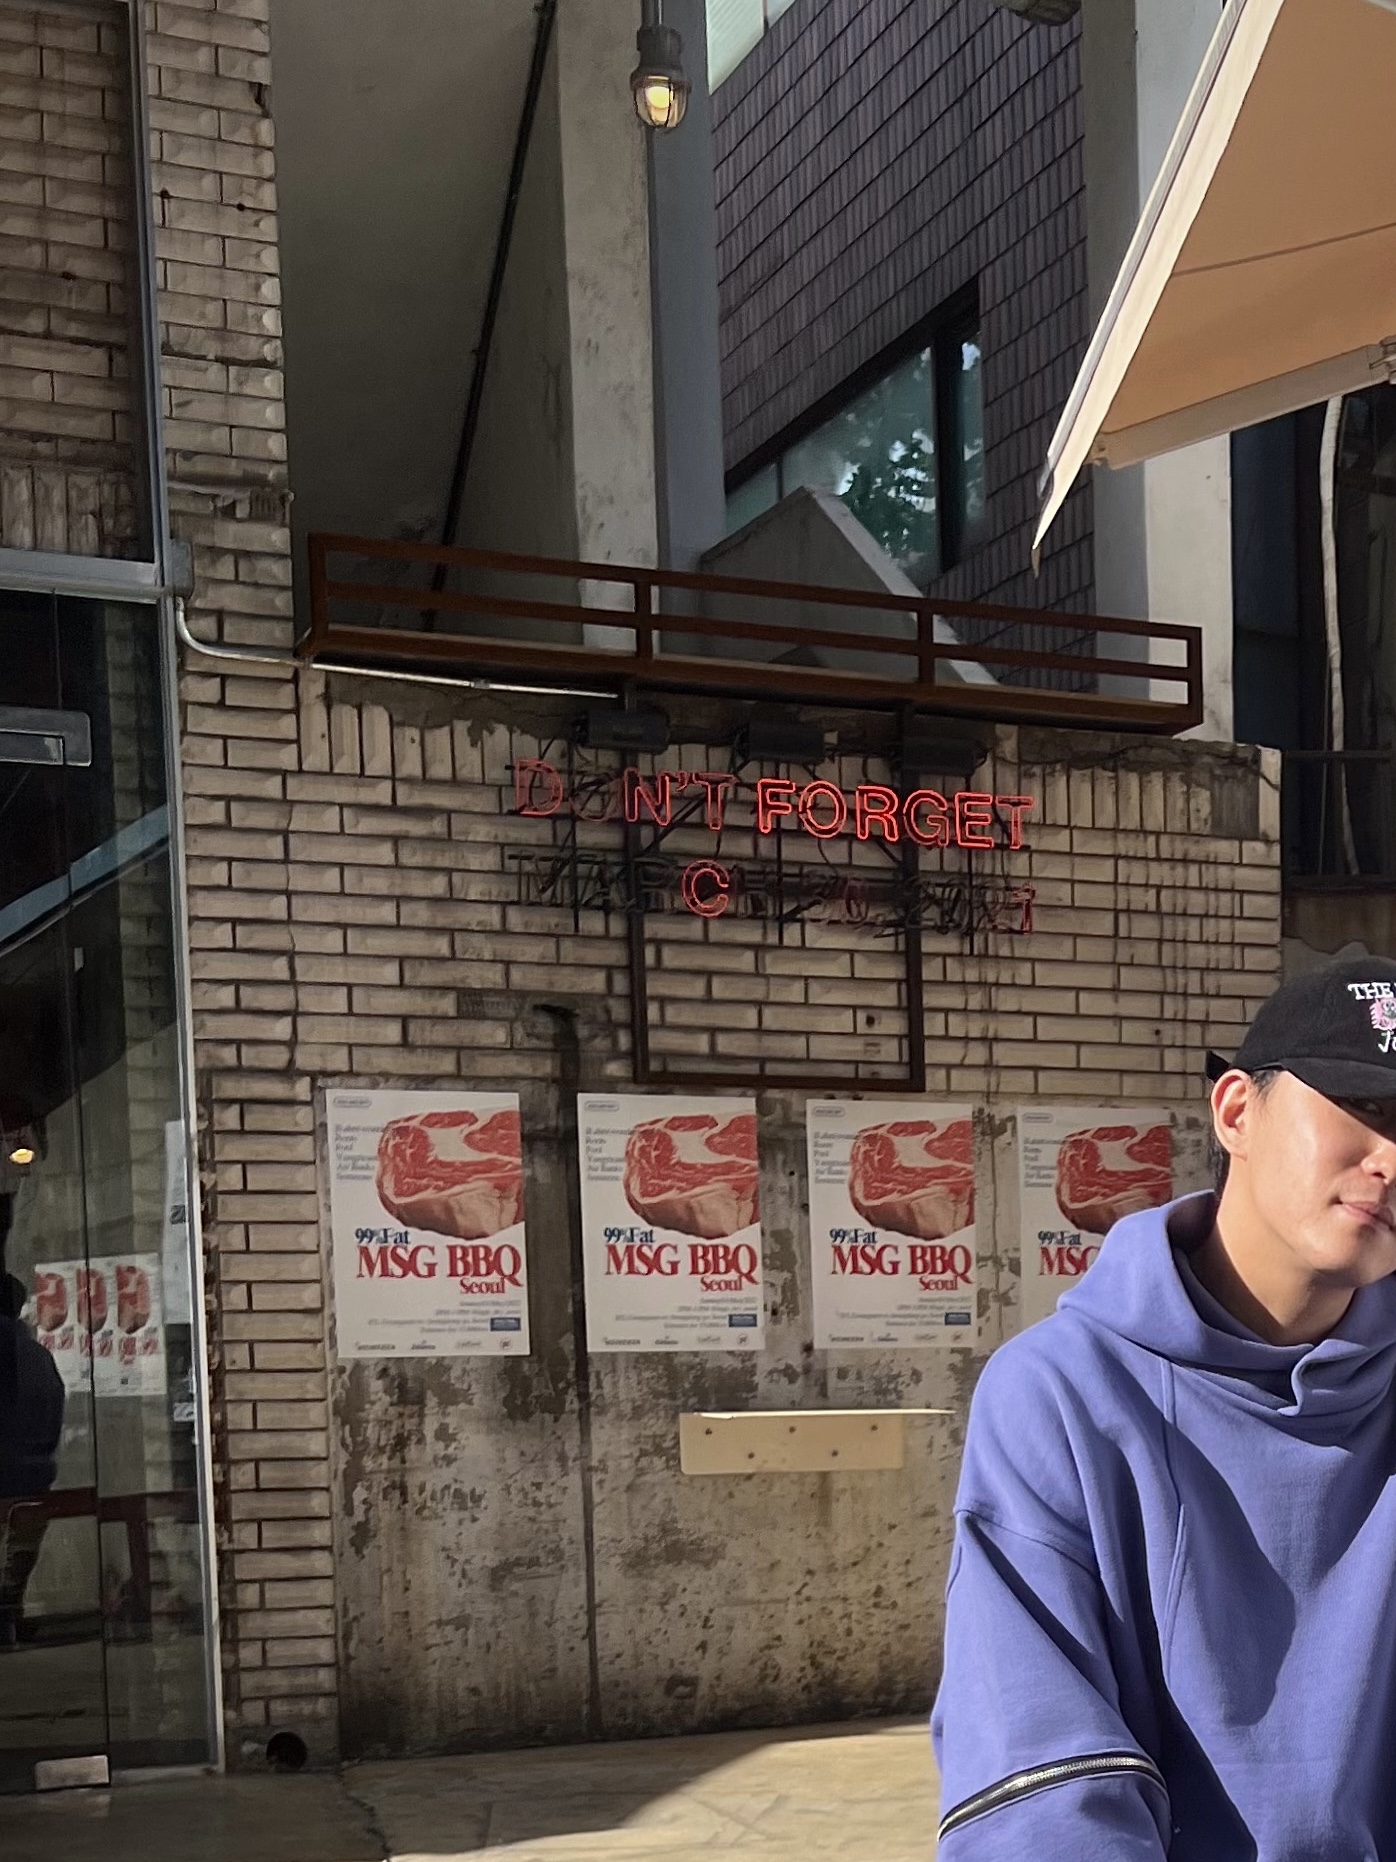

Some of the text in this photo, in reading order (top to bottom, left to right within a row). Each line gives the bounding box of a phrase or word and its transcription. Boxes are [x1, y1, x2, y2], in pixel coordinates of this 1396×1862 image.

[515, 758, 1034, 850] DON'T FORGET
[1347, 982, 1393, 1001] THE
[356, 1244, 523, 1287] MSG BBQ
[605, 1243, 759, 1285] MSG BBQ
[831, 1244, 974, 1284] MSG BBQ
[460, 1277, 505, 1294] Seoul
[700, 1276, 743, 1292] Seoul
[919, 1275, 958, 1291] Seoul
